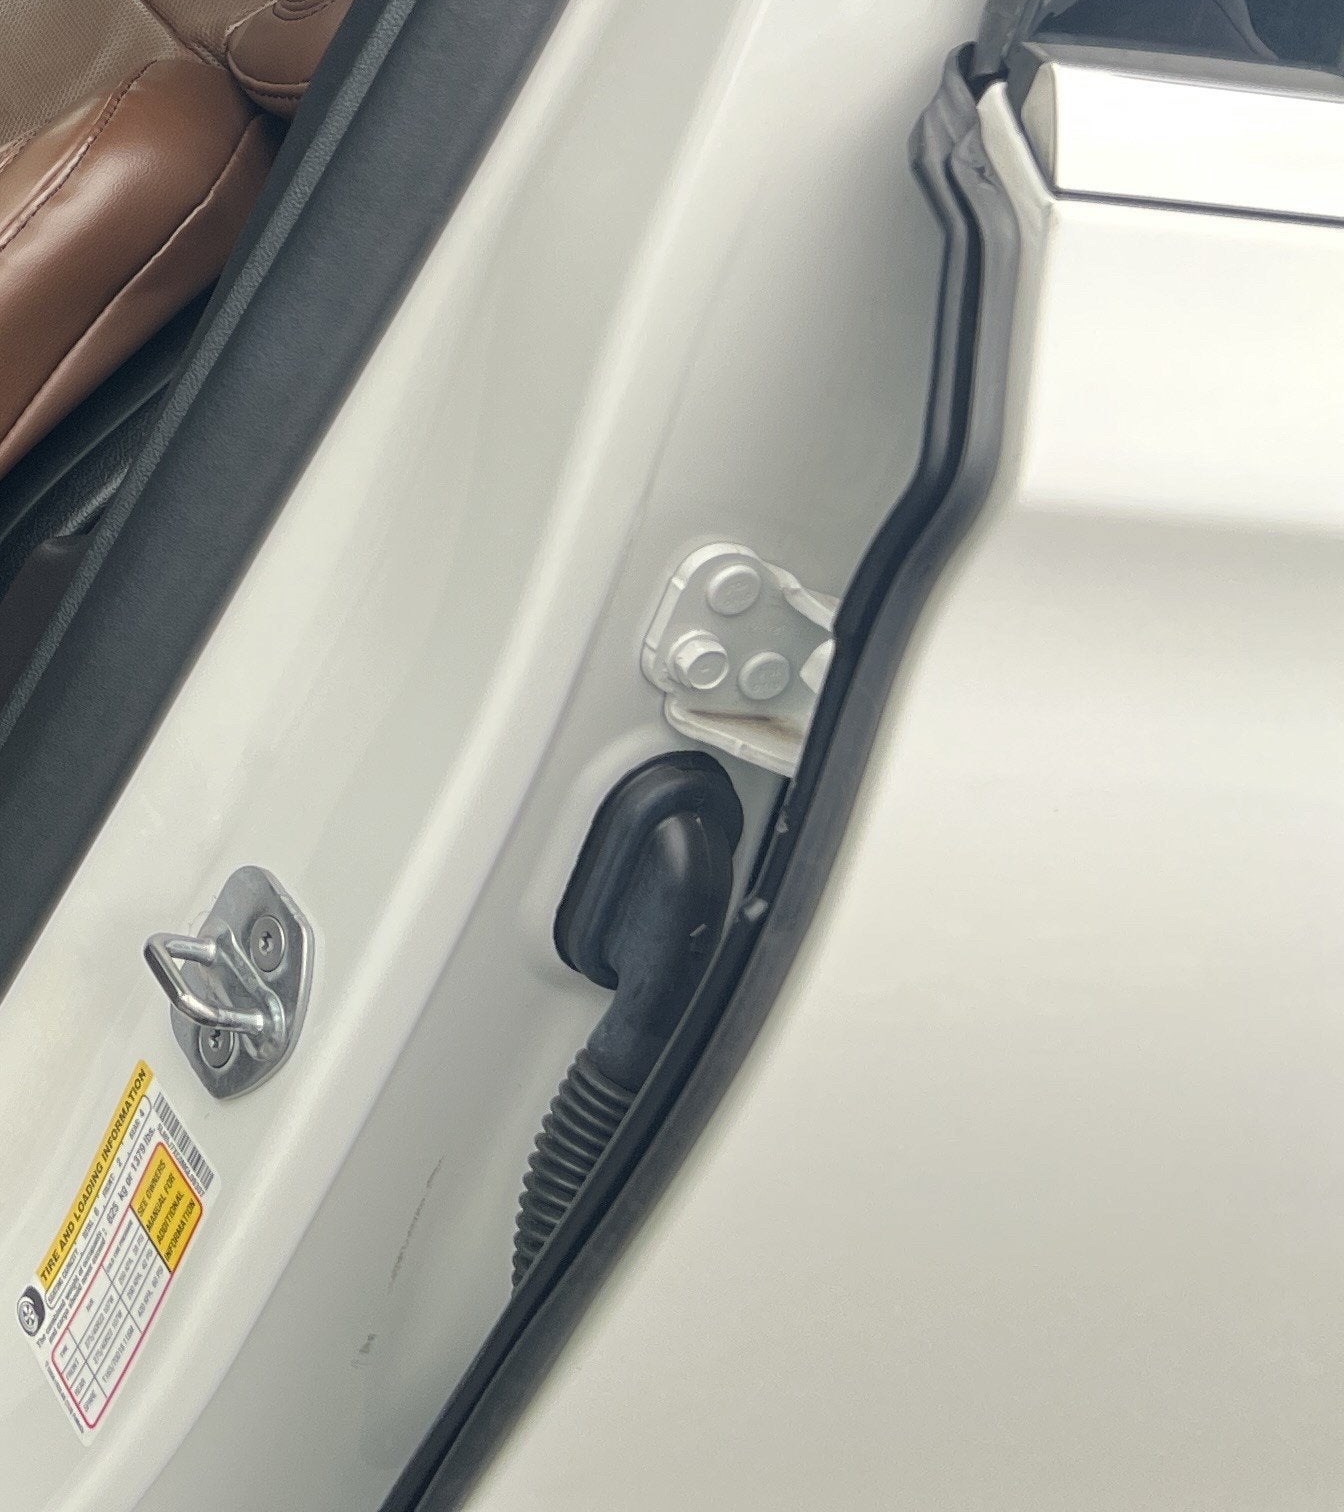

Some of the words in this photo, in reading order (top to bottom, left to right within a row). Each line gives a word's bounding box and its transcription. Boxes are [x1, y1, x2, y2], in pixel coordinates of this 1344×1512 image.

[40, 1249, 60, 1282] TIRE
[57, 1219, 75, 1250] AND
[72, 1161, 103, 1220] LOADING
[100, 1068, 147, 1161] INFORMATION
